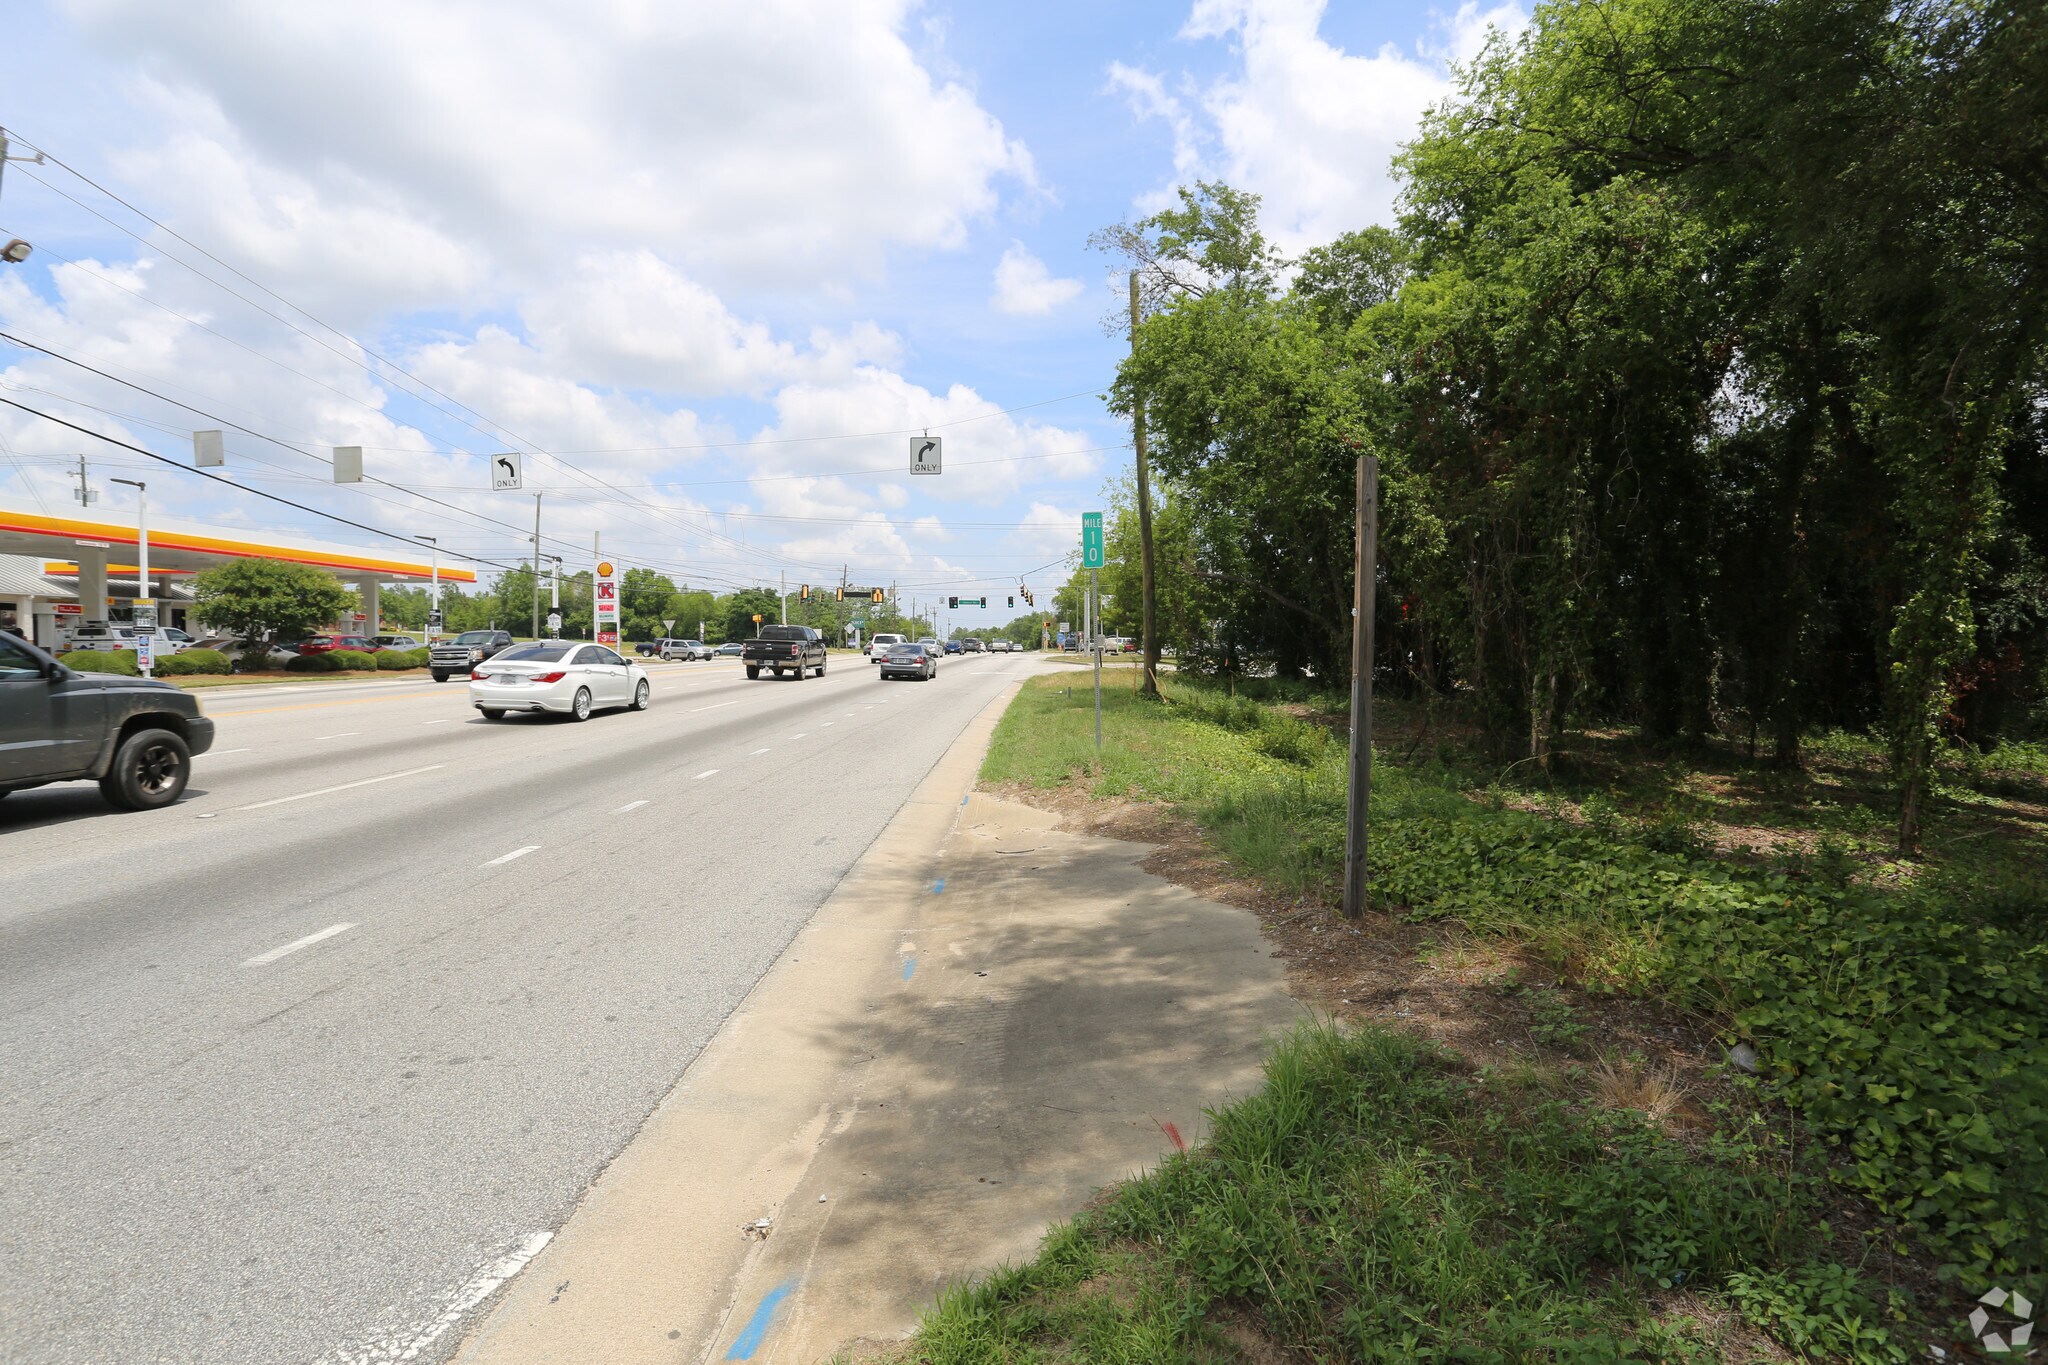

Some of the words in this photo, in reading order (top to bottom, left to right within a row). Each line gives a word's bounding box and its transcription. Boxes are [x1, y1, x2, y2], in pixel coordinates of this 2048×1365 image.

[915, 464, 937, 472] ONLY
[497, 480, 518, 488] ONLY
[1084, 518, 1102, 528] MILE
